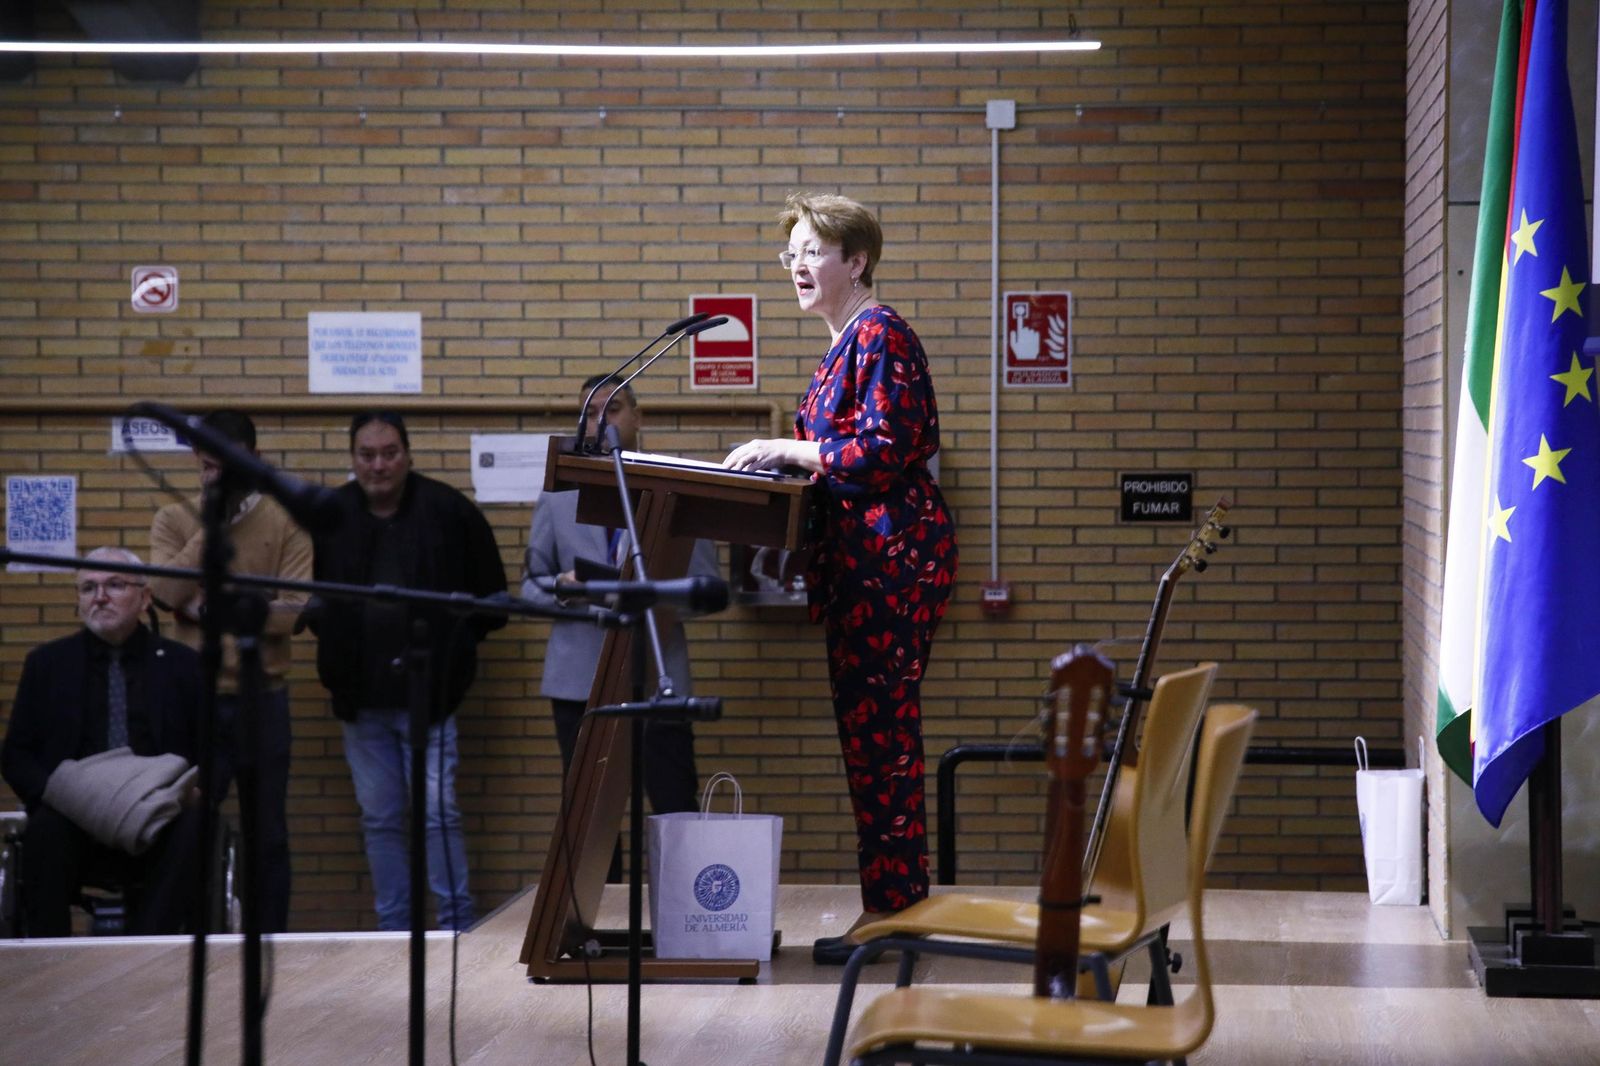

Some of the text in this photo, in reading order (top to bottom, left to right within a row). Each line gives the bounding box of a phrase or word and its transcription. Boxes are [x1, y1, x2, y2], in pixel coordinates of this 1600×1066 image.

[1123, 480, 1189, 494] PROHIBIDO
[1132, 501, 1181, 515] FUMAR
[684, 913, 749, 923] UNIVERSIDAD
[684, 921, 748, 933] DE ALMERÍA
